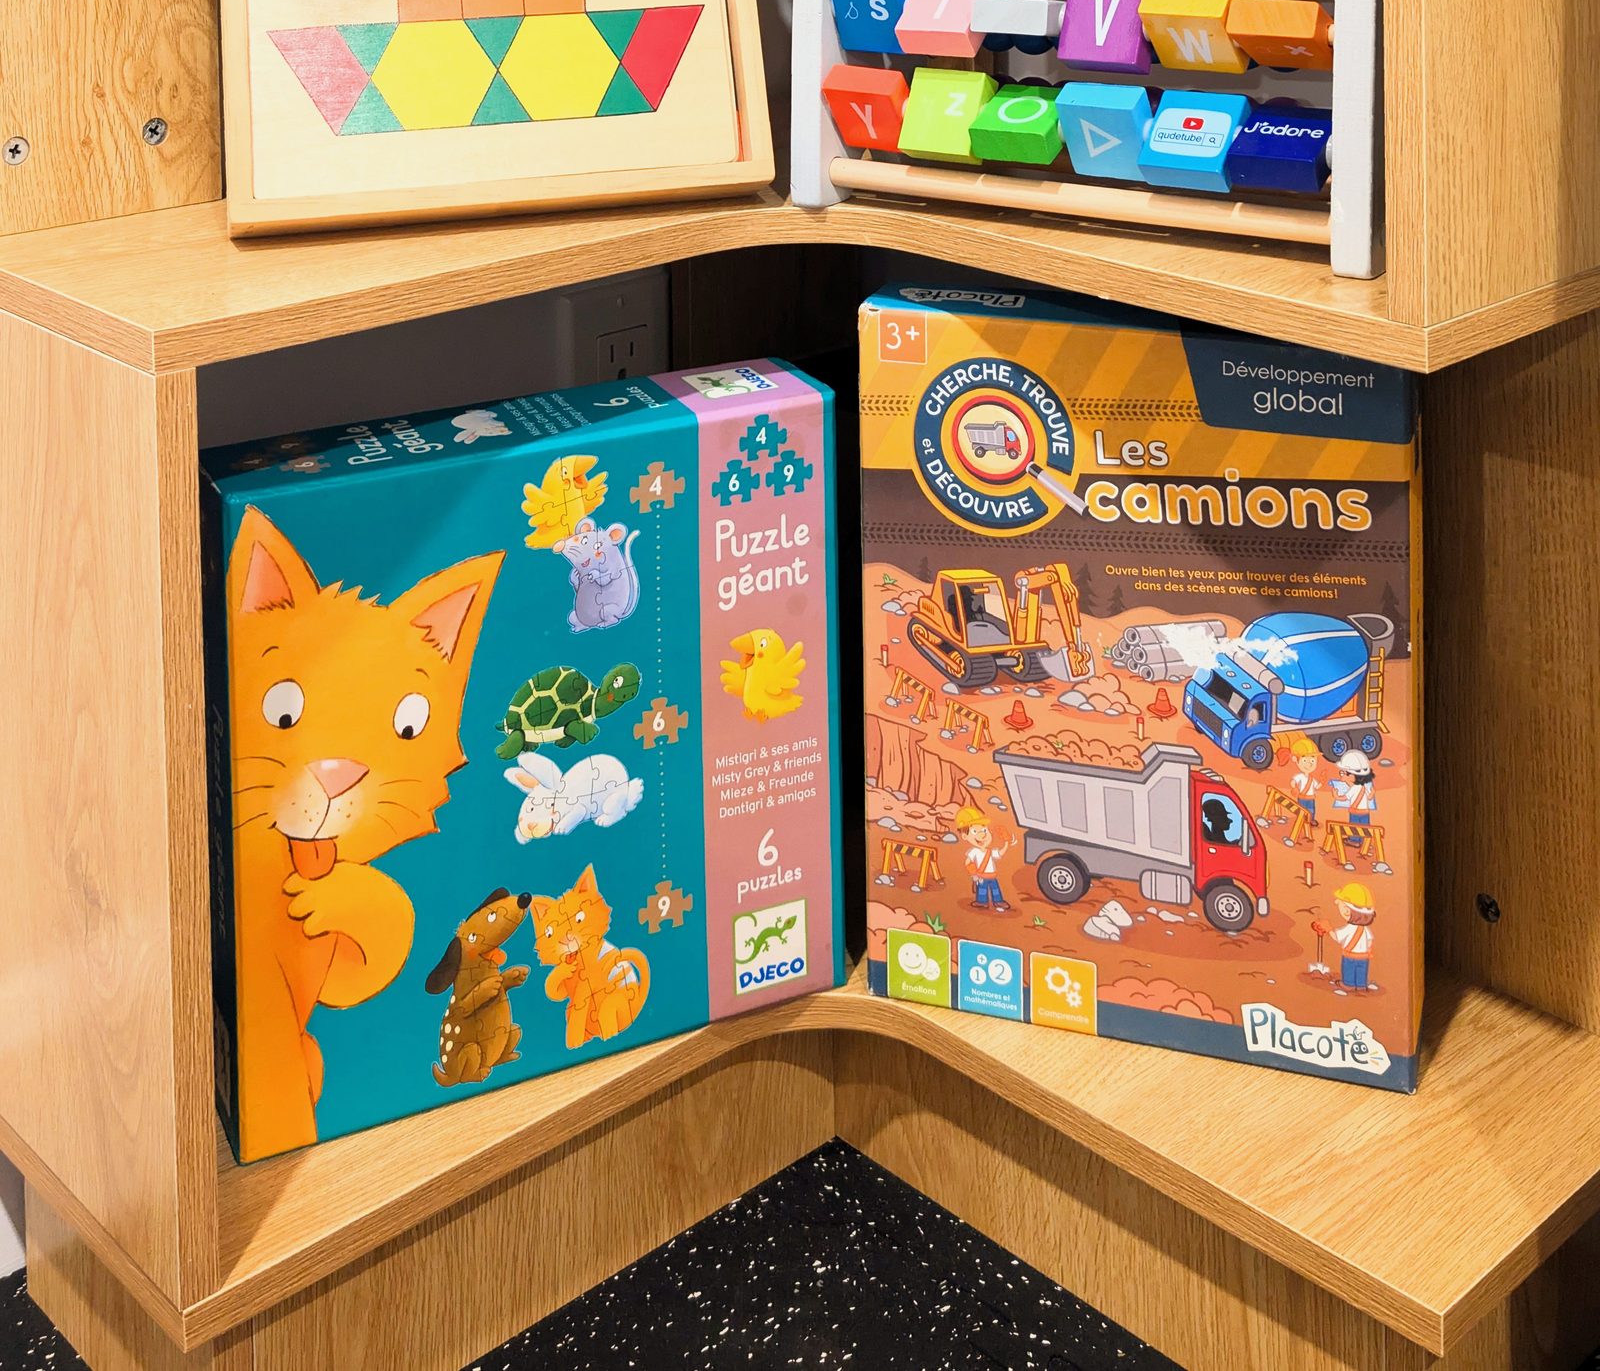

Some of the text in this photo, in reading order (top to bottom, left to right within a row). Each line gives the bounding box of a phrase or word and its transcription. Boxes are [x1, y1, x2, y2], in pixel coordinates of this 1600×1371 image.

[1167, 27, 1213, 64] W
[850, 102, 877, 139] Y
[1244, 121, 1325, 139] J'adore
[1158, 131, 1203, 143] qudetube
[886, 322, 920, 350] 3+
[1222, 360, 1375, 388] Développement
[925, 363, 1070, 455] CHERCHE, TROUVE
[1253, 388, 1343, 416] global
[337, 425, 393, 465] Puzzle
[381, 419, 444, 454] géant
[756, 426, 767, 444] 4
[1094, 430, 1169, 467] Les
[649, 476, 662, 496] 4
[728, 464, 794, 492] 6 9
[922, 438, 1034, 519] et DÉCOUVRE
[1084, 467, 1372, 531] camions
[715, 514, 810, 562] Puzzle
[718, 557, 809, 611] géant
[1105, 565, 1367, 585] Ouvre bien tes yeux pour trouver des éléments
[1135, 580, 1338, 599] dans des scènes avec des camions!
[652, 711, 665, 732] 6
[715, 736, 818, 769] Mistigri & ses amis
[712, 752, 822, 787] Misty Grey & friends
[720, 771, 815, 802] Mieze & Freunde
[719, 787, 817, 819] Dontigri & amigos
[757, 828, 779, 866] 6
[737, 866, 802, 904] puzzles
[657, 896, 671, 917] 9
[739, 957, 805, 989] DJECO
[902, 982, 937, 996] Émotions
[964, 995, 1018, 1012] mathématiques
[971, 988, 1011, 1002] Nombres et
[1037, 1008, 1090, 1024] Comprendre
